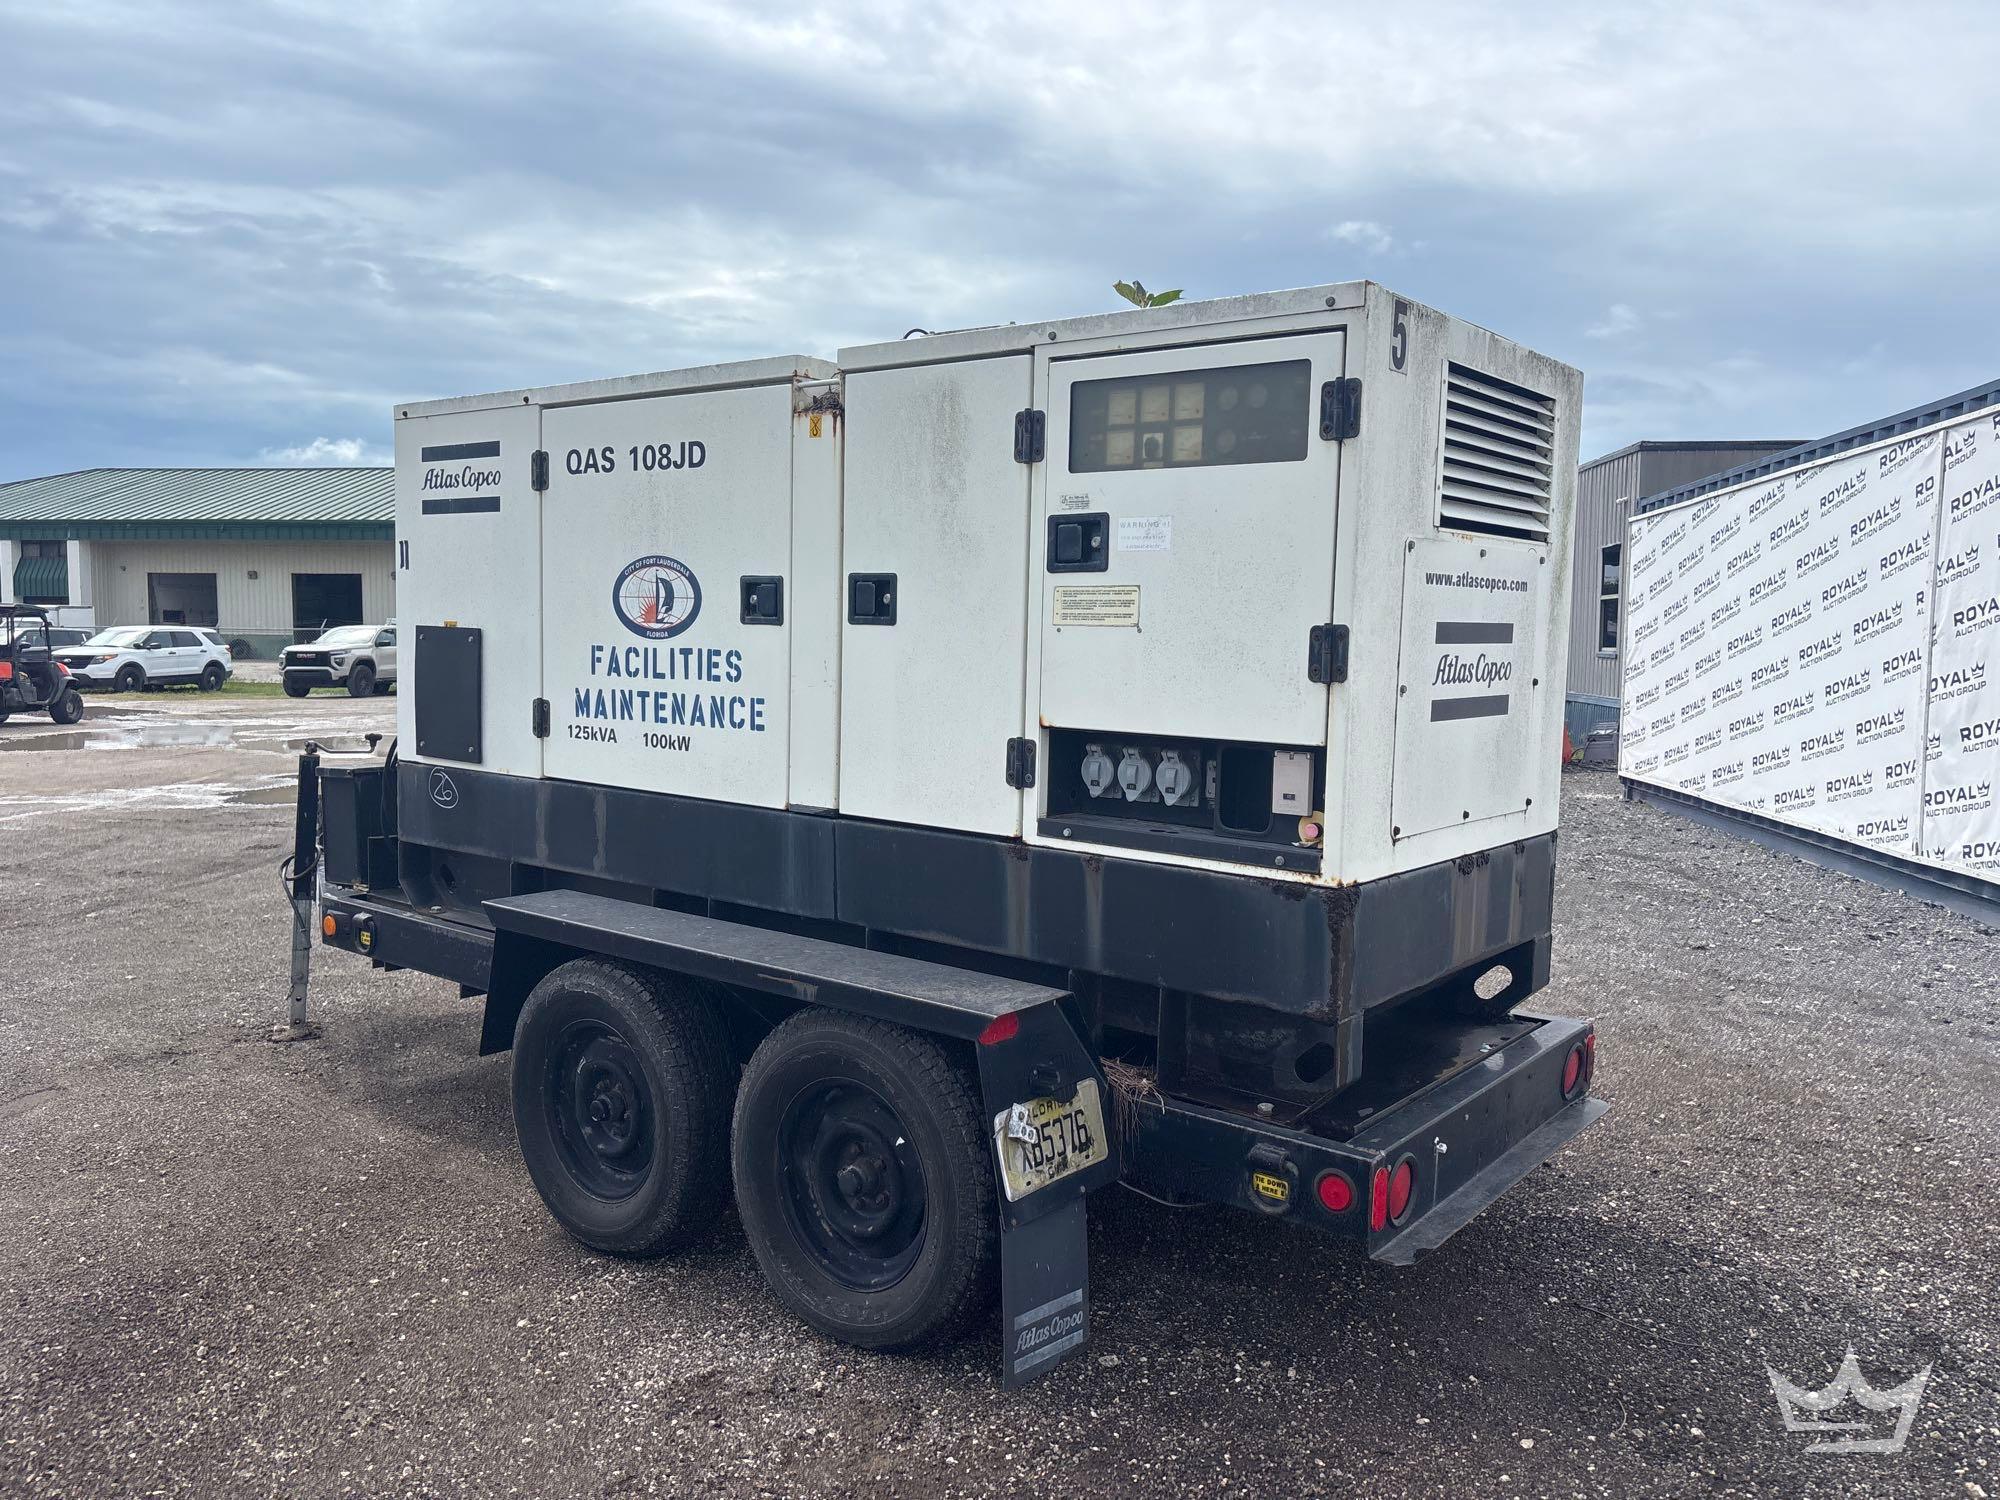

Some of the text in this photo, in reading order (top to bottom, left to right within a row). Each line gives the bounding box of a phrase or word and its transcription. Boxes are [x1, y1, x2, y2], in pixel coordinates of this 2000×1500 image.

[1391, 299, 1408, 370] 5
[565, 441, 707, 475] QAS 108JD
[1880, 454, 1909, 479] AUCTION
[1910, 437, 1934, 458] GROUP
[1948, 447, 1977, 470] GROUP
[421, 465, 501, 491] Atlas Copco
[1795, 472, 1818, 490] AUCTION
[1749, 488, 1777, 515] ROYAL
[1820, 477, 1856, 509] ROYAL
[1820, 483, 1866, 518] AUCTION GROUP
[1749, 493, 1785, 523] AUCTION GROUP
[1951, 499, 1988, 525] AUCTION
[1770, 515, 1800, 543] ROYAL
[1850, 505, 1889, 537] ROYAL
[1851, 512, 1901, 547] AUCTION GROUP
[1661, 526, 1680, 549] ROYAL
[1710, 521, 1733, 545] ROYAL
[1710, 526, 1740, 553] AUCTION GROUP
[1770, 521, 1809, 551] AUCTION GROUP
[1633, 552, 1651, 573] ROYAL
[1678, 549, 1698, 571] ROYAL
[1727, 547, 1753, 572] ROYAL
[1796, 542, 1829, 570] ROYAL
[1796, 549, 1838, 579] AUCTION GROUP
[1880, 539, 1921, 570] ROYAL
[624, 558, 690, 577] CITY OF FORT LAUDERDALE
[1727, 553, 1760, 580] AUCTION GROUP
[1881, 560, 1909, 580] AUCTION
[1950, 562, 1980, 582] GROUP
[1425, 571, 1528, 593] www.atlascopco.com
[1649, 574, 1667, 594] ROYAL
[1694, 575, 1714, 597] ROYAL
[1749, 574, 1778, 598] ROYAL
[1822, 575, 1857, 602] ROYAL
[1749, 581, 1786, 607] AUCTION GROUP
[1822, 583, 1867, 612] AUCTION GROUP
[1663, 599, 1682, 619] ROYAL
[1711, 601, 1733, 622] ROYAL
[1711, 608, 1739, 630] AUCTION GROUP
[1771, 605, 1802, 629] ROYAL
[1634, 620, 1653, 638] ROYAL
[1772, 613, 1811, 638] AUCTION GROUP
[1853, 608, 1891, 636] ROYAL
[1854, 617, 1902, 646] AUCTION GROUP
[1955, 617, 1993, 638] AUCTION
[646, 630, 669, 638] FLORIDA
[1680, 623, 1699, 643] ROYAL
[1727, 630, 1754, 652] ROYAL
[1651, 644, 1669, 662] ROYAL
[1727, 638, 1762, 660] AUCTION GROUP
[1799, 637, 1832, 661] ROYAL
[1799, 646, 1841, 670] AUCTION GROUP
[591, 644, 743, 683] FACILITIES
[1432, 653, 1512, 688] Atlas Copco
[1695, 652, 1715, 672] ROYAL
[1751, 661, 1780, 682] ROYAL
[1883, 648, 1923, 674] ROYAL
[1665, 671, 1684, 689] ROYAL
[1751, 670, 1788, 691] AUCTION GROUP
[1825, 674, 1860, 697] ROYAL
[1883, 667, 1910, 684] AUCTION
[1636, 687, 1654, 704] ROYAL
[1711, 682, 1735, 700] ROYAL
[1825, 684, 1870, 706] AUCTION GROUP
[1956, 679, 1987, 696] GROUP
[574, 687, 766, 732] MAINTENANCE
[1681, 699, 1700, 716] ROYAL
[1711, 690, 1741, 708] AUCTION GROUP
[1773, 696, 1805, 716] ROYAL
[1651, 715, 1670, 730] ROYAL
[1729, 715, 1756, 733] ROYAL
[1773, 706, 1814, 725] AUCTION GROUP
[1856, 713, 1893, 735] ROYAL
[567, 724, 691, 751] 125kVA 100kW
[1695, 731, 1715, 747] ROYAL
[1729, 724, 1764, 740] AUCTION GROUP
[1800, 733, 1835, 752] ROYAL
[1856, 724, 1904, 745] AUCTION GROUP
[1664, 744, 1683, 759] ROYAL
[1801, 743, 1844, 761] AUCTION GROUP
[1962, 737, 2000, 754] AUCTION
[1635, 757, 1653, 770] ROYAL
[1752, 749, 1781, 767] ROYAL
[1752, 759, 1789, 775] AUCTION GROUP
[1712, 763, 1736, 779] ROYAL
[1712, 773, 1743, 787] AUCTION GROUP
[1826, 774, 1862, 793] ROYAL
[1886, 776, 1915, 790] AUCTION
[1774, 788, 1805, 804] ROYAL
[1827, 787, 1872, 803] AUCTION GROUP
[1925, 785, 1977, 807] ROYAL
[1774, 800, 1814, 813] AUCTION GROUP
[1926, 799, 1991, 819] AUCTION GROUP
[1857, 819, 1897, 836] ROYAL
[1886, 833, 1908, 841] GROUP
[1255, 1175, 1287, 1190] TIE DOWN
[1261, 1185, 1278, 1195] HERE
[1013, 1310, 1083, 1354] Atlas Copco
